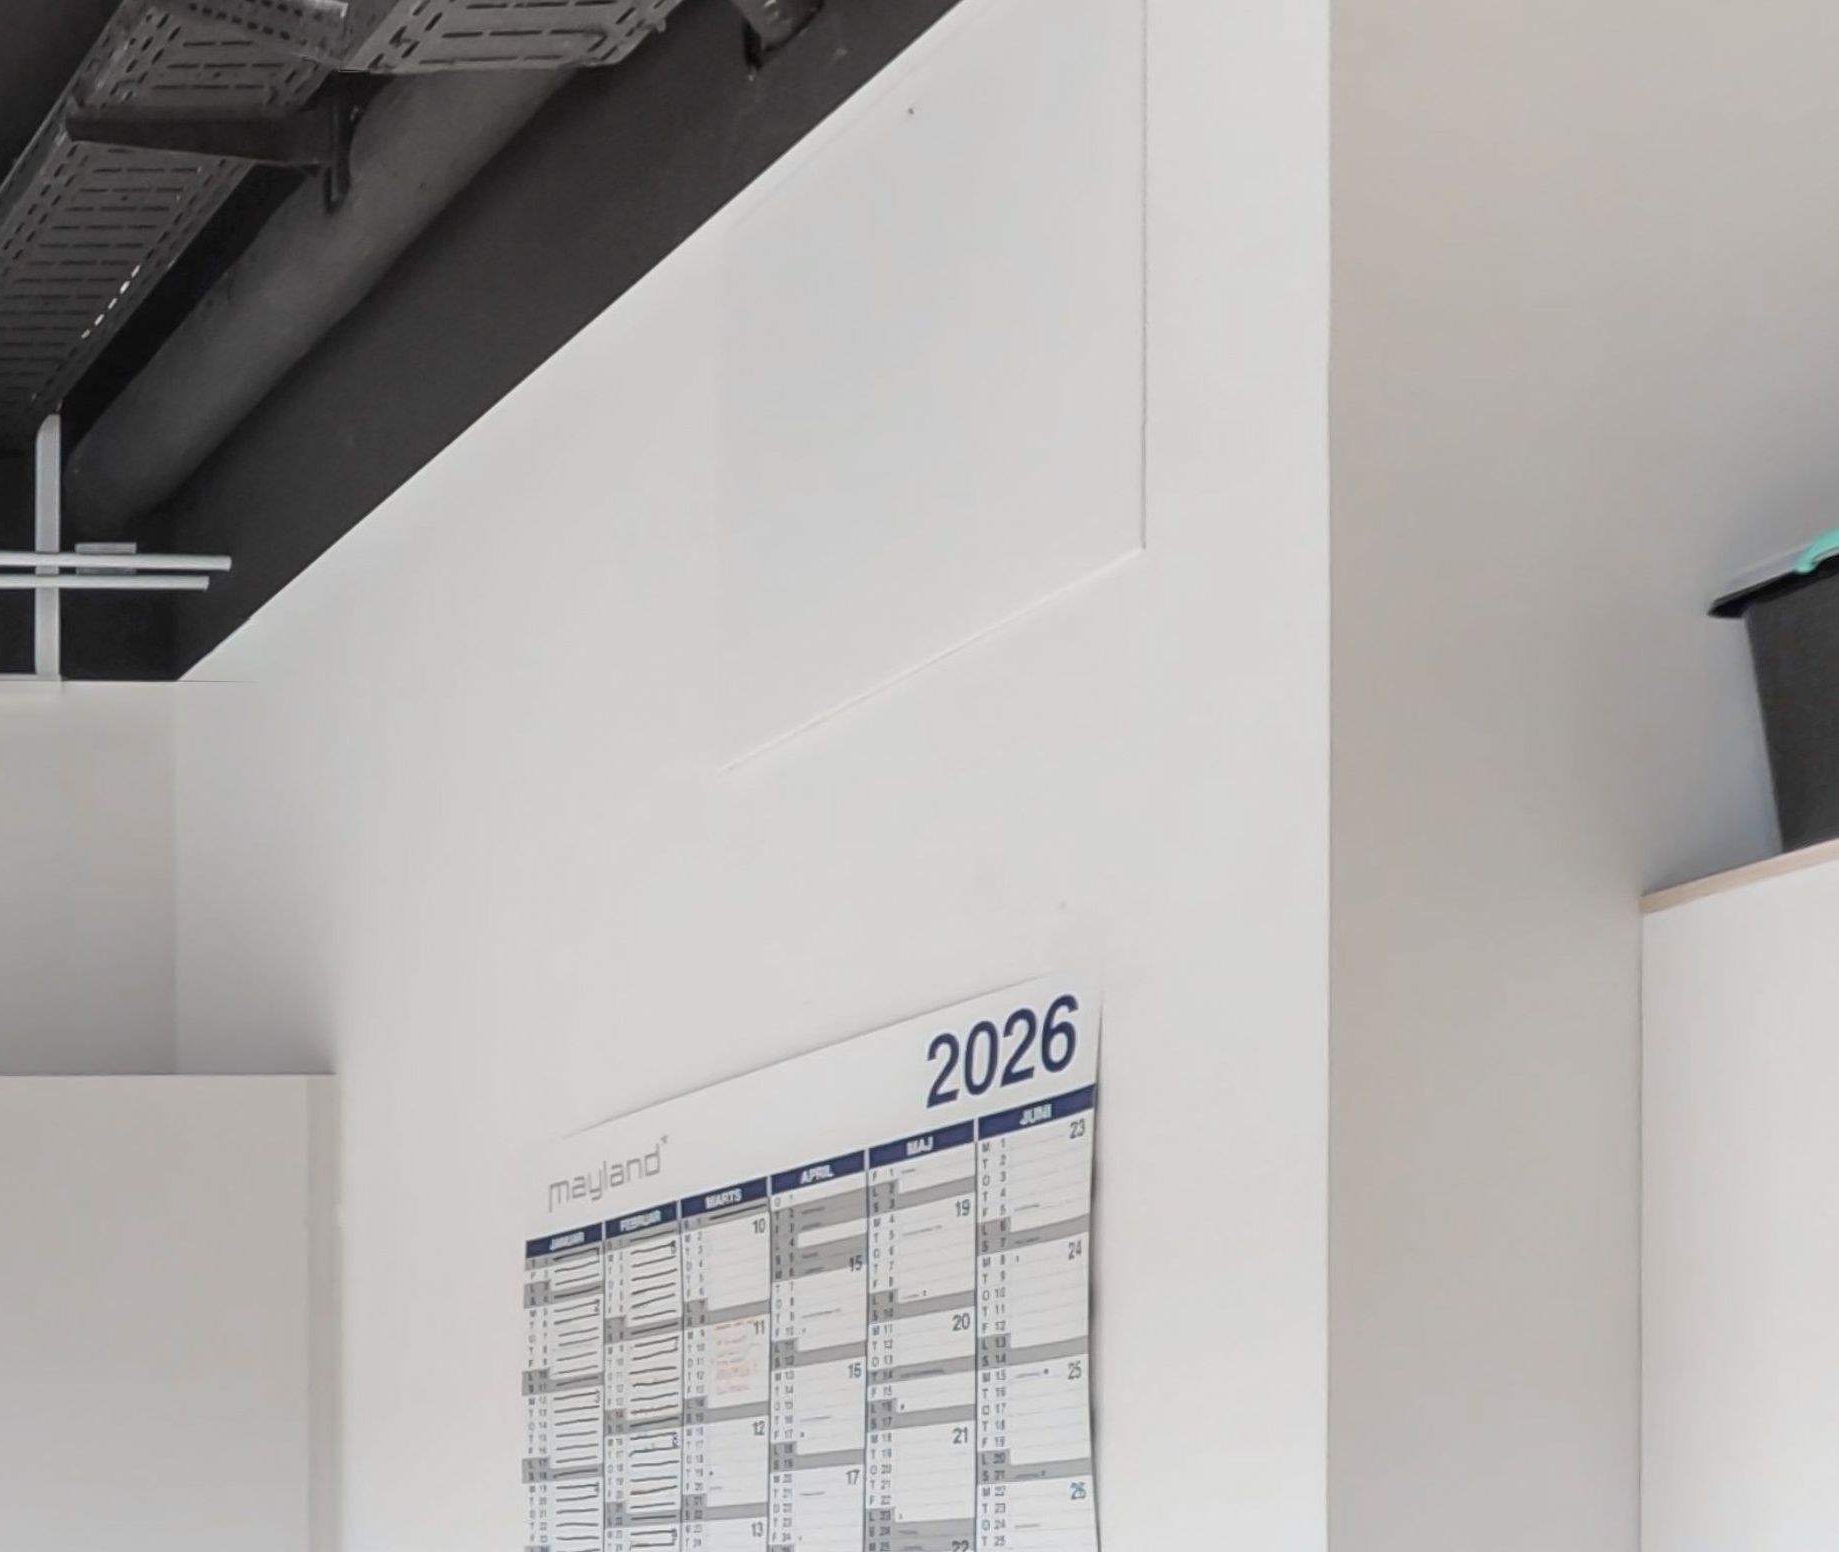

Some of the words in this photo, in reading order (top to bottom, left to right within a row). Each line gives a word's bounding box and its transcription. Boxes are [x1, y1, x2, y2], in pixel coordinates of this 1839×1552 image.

[926, 994, 1079, 1109] 2026
[1069, 1119, 1086, 1139] 23
[906, 1136, 934, 1156] MAJ
[548, 1143, 660, 1213] mayland
[705, 1188, 743, 1209] MARTS
[955, 1199, 970, 1218] 19
[1068, 1241, 1083, 1261] 24
[952, 1313, 971, 1332] 20
[1067, 1361, 1083, 1381] 25
[952, 1427, 969, 1444] 21
